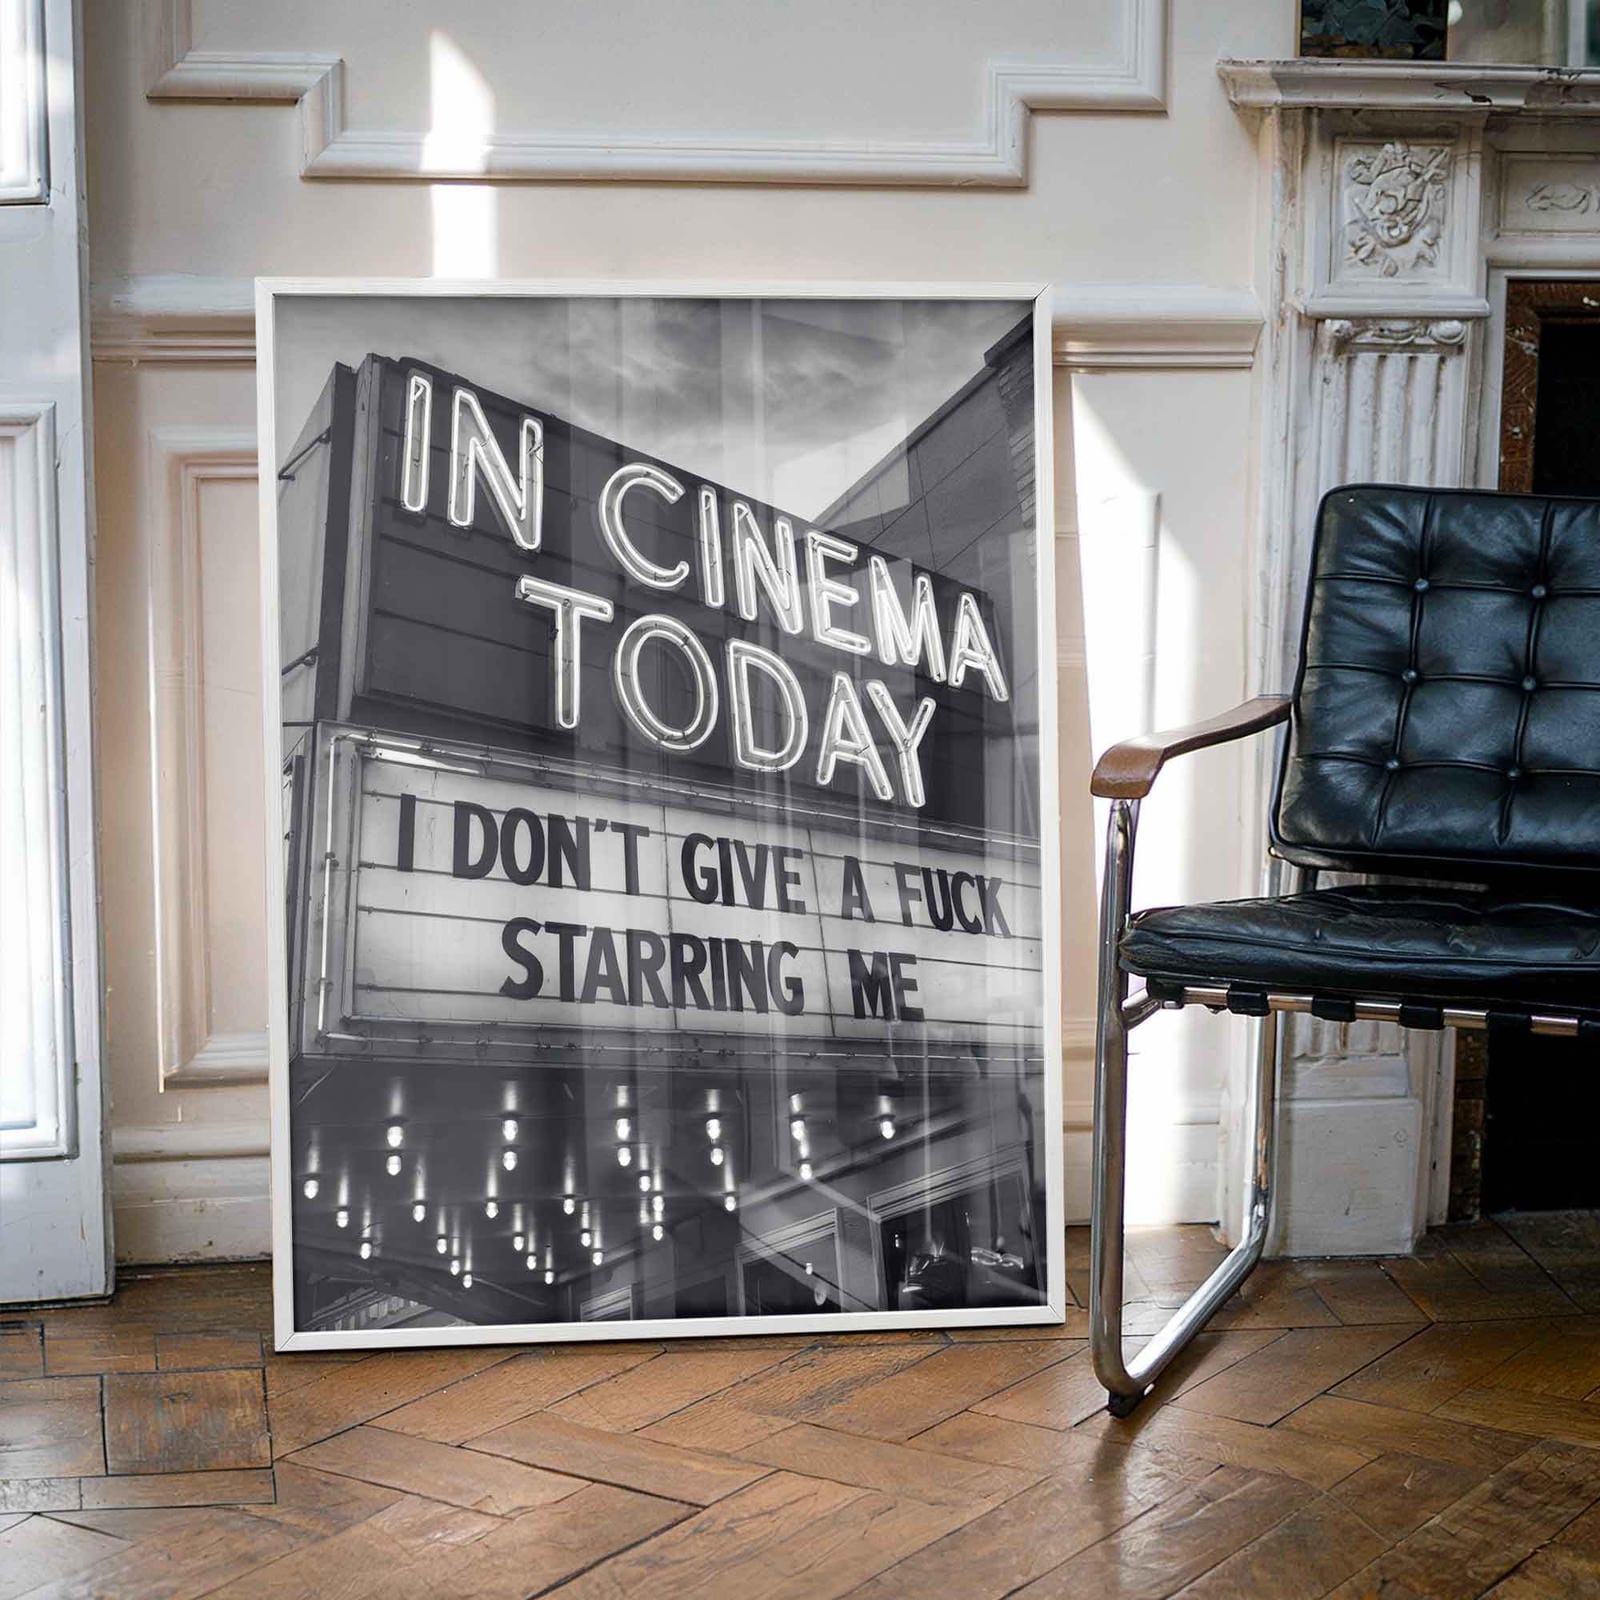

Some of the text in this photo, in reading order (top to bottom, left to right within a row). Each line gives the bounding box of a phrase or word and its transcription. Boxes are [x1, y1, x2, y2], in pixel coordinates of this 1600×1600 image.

[402, 373, 1009, 702] IN CINEMA
[518, 575, 936, 808] TODAY
[399, 793, 1013, 938] I DON'T GIVE A FUCK
[500, 916, 925, 1022] STARRING ME
